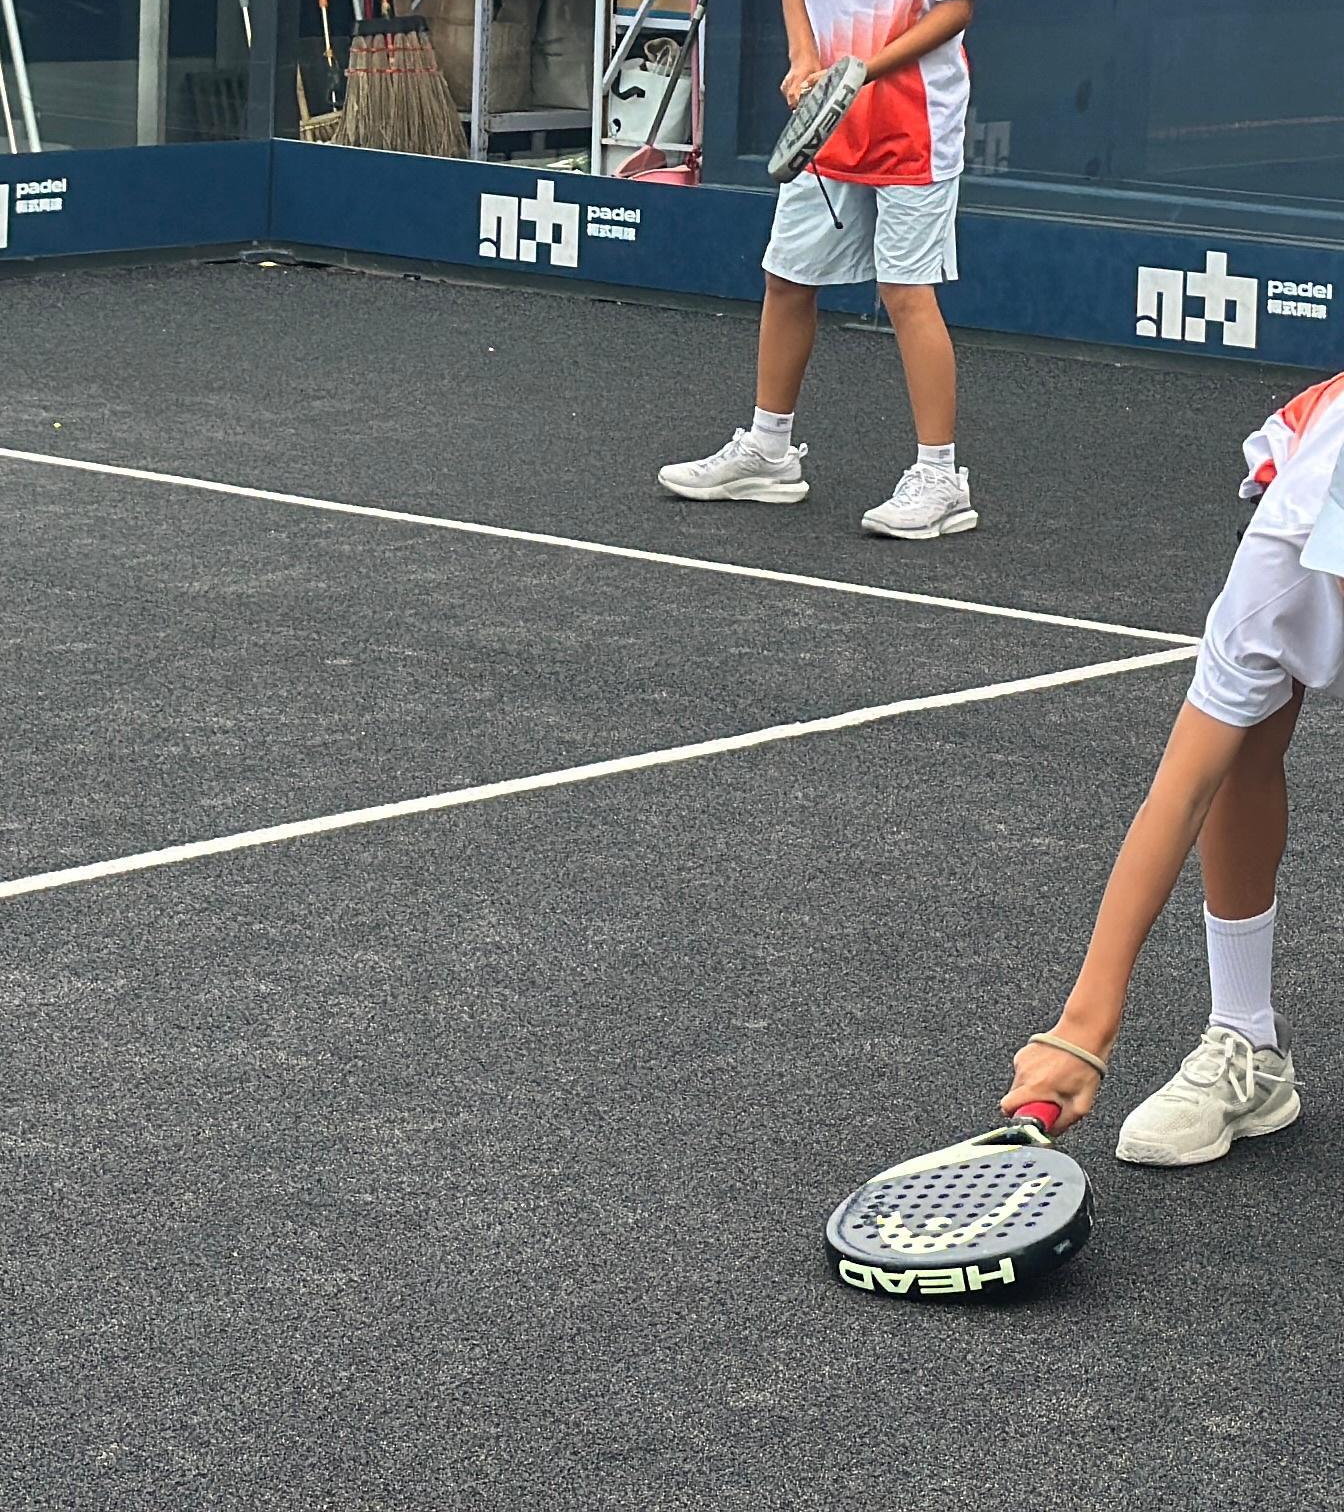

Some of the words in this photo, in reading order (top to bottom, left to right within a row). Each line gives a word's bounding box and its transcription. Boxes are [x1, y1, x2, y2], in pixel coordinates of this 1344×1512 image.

[788, 84, 855, 171] HEAD
[15, 178, 67, 199] padel
[587, 205, 641, 224] padel
[1267, 279, 1333, 300] padel
[838, 1257, 1015, 1295] HEAD
